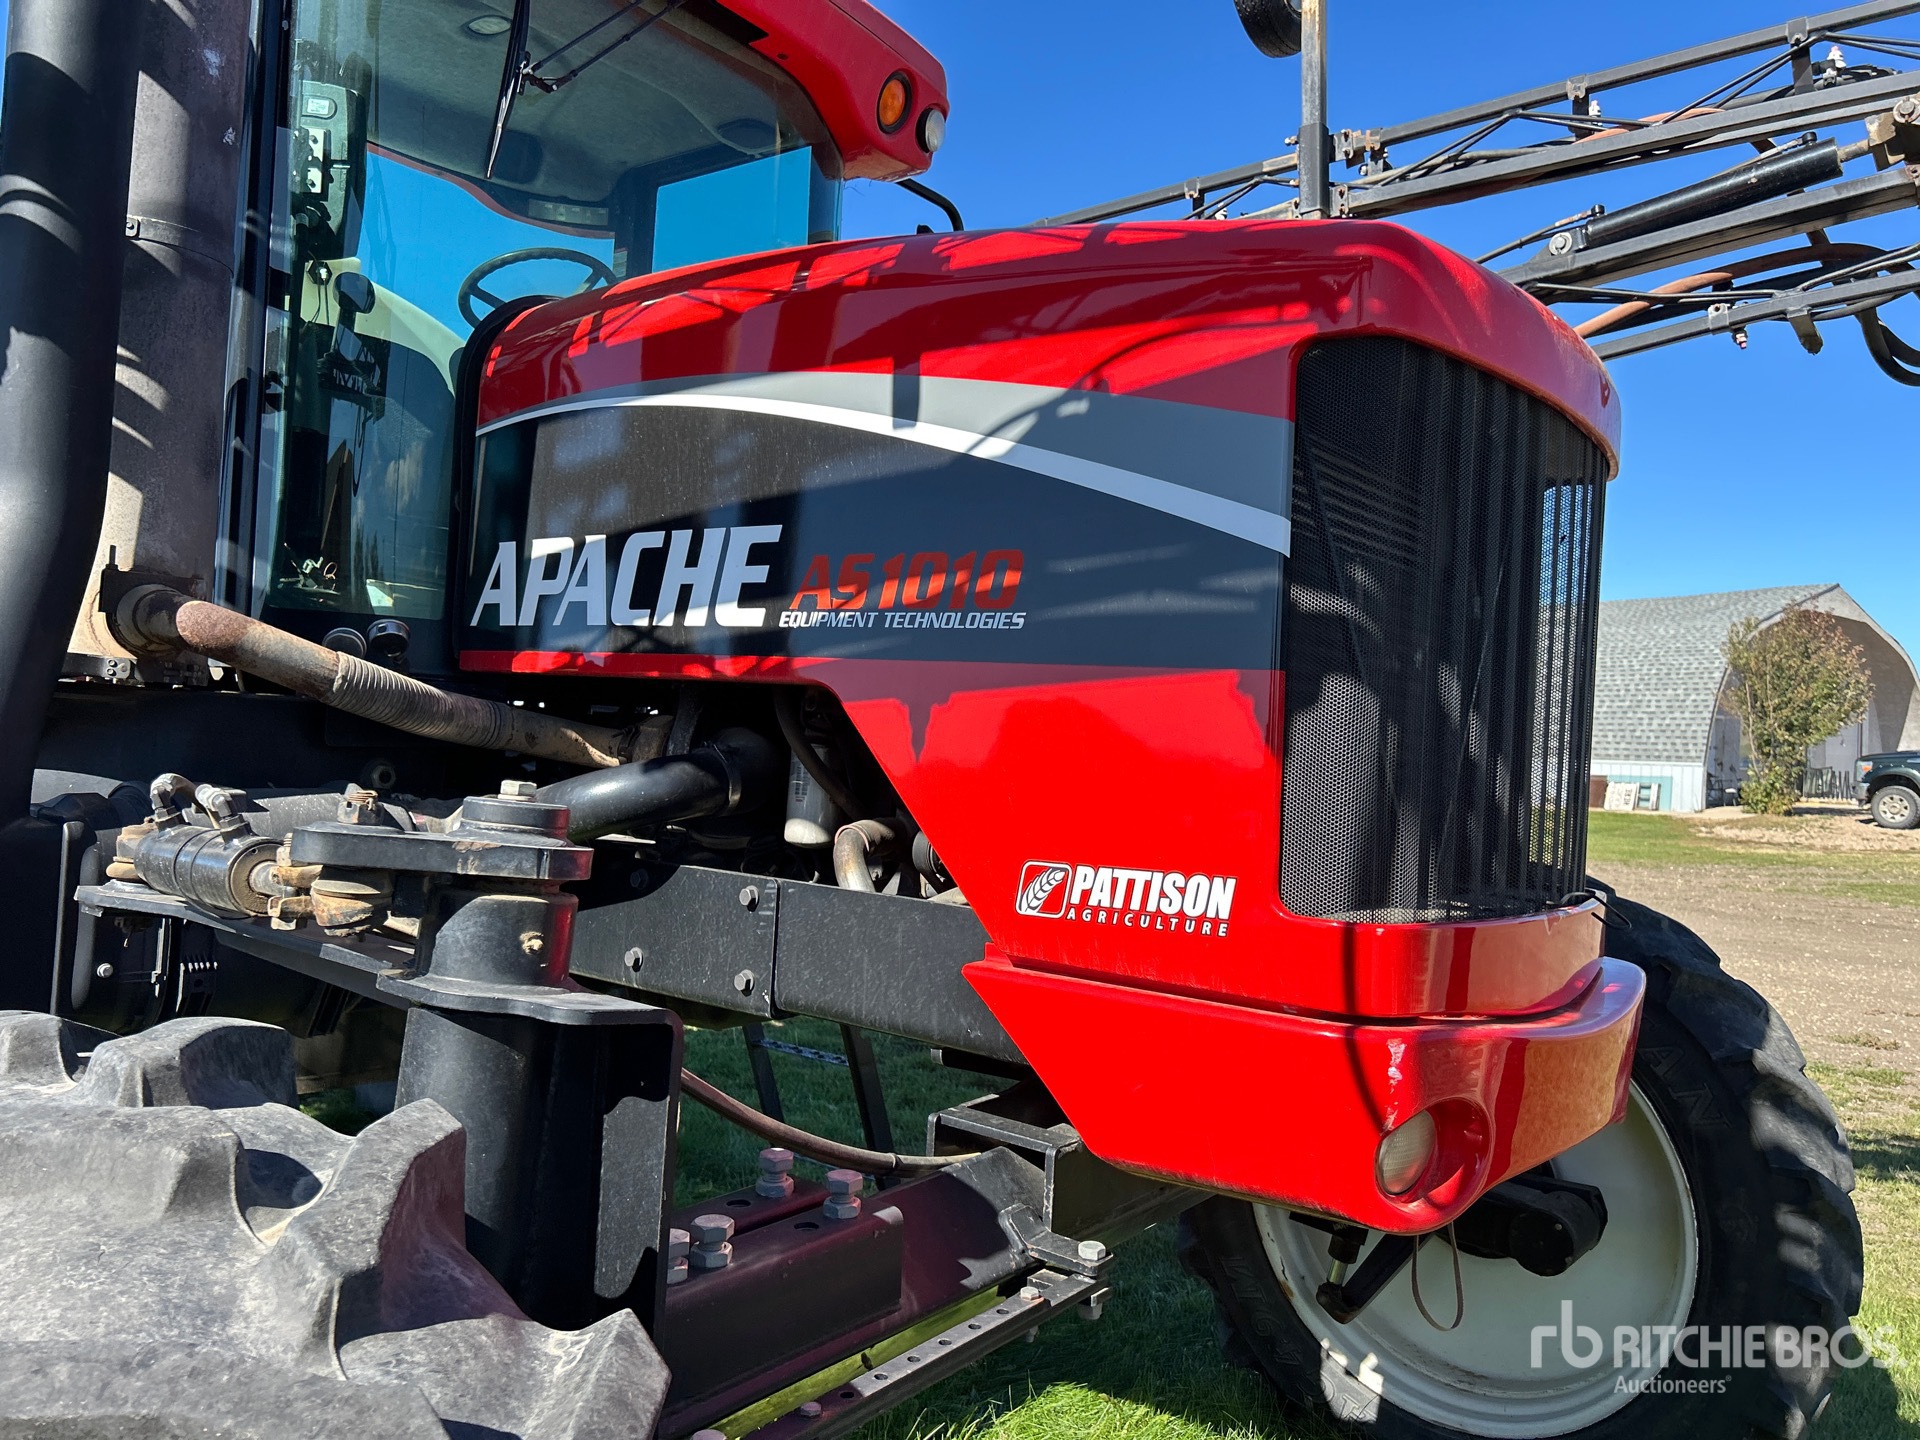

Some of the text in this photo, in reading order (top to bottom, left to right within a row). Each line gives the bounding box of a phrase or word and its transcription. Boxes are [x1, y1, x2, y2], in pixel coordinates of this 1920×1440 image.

[470, 524, 782, 627] APACHE
[778, 611, 1027, 630] EQUIPMENT TECHNOLOGIES
[1069, 864, 1238, 920] PATTISON
[1066, 907, 1230, 937] AGRICULTURE
